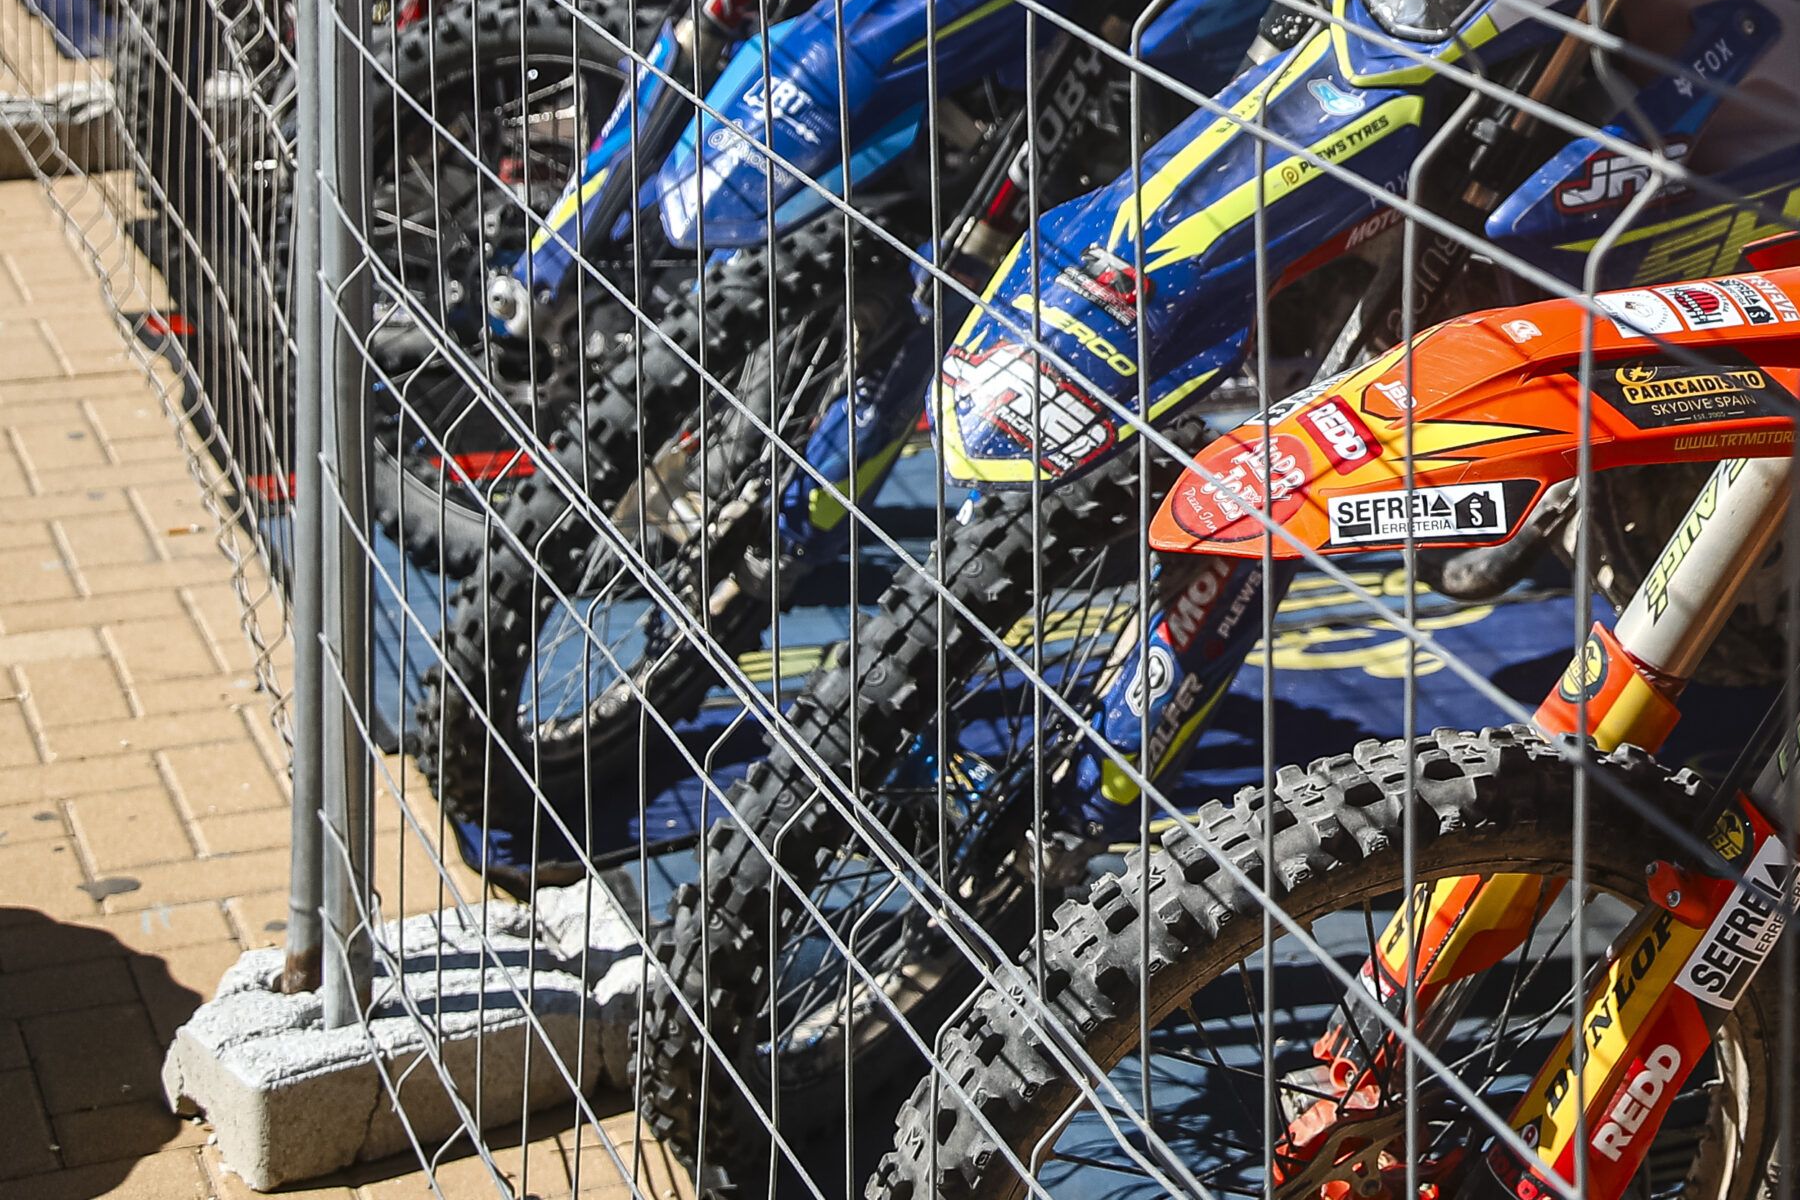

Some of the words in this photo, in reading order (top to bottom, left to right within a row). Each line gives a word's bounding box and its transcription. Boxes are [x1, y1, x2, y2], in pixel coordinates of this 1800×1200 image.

[1693, 38, 1734, 79] FOX
[1346, 115, 1390, 150] TYRES
[1345, 211, 1404, 249] MOT
[1628, 373, 1761, 401] PARACAIDISMO
[1651, 397, 1711, 416] SKYDIVE
[1715, 394, 1757, 409] SPAIN
[1307, 403, 1367, 460] REDD
[1182, 487, 1203, 513] Pizza
[1198, 511, 1218, 534] Inn
[1143, 672, 1206, 776] ALFER
[1546, 910, 1676, 1116] DUNLOP
[1592, 1044, 1682, 1162] REDD
